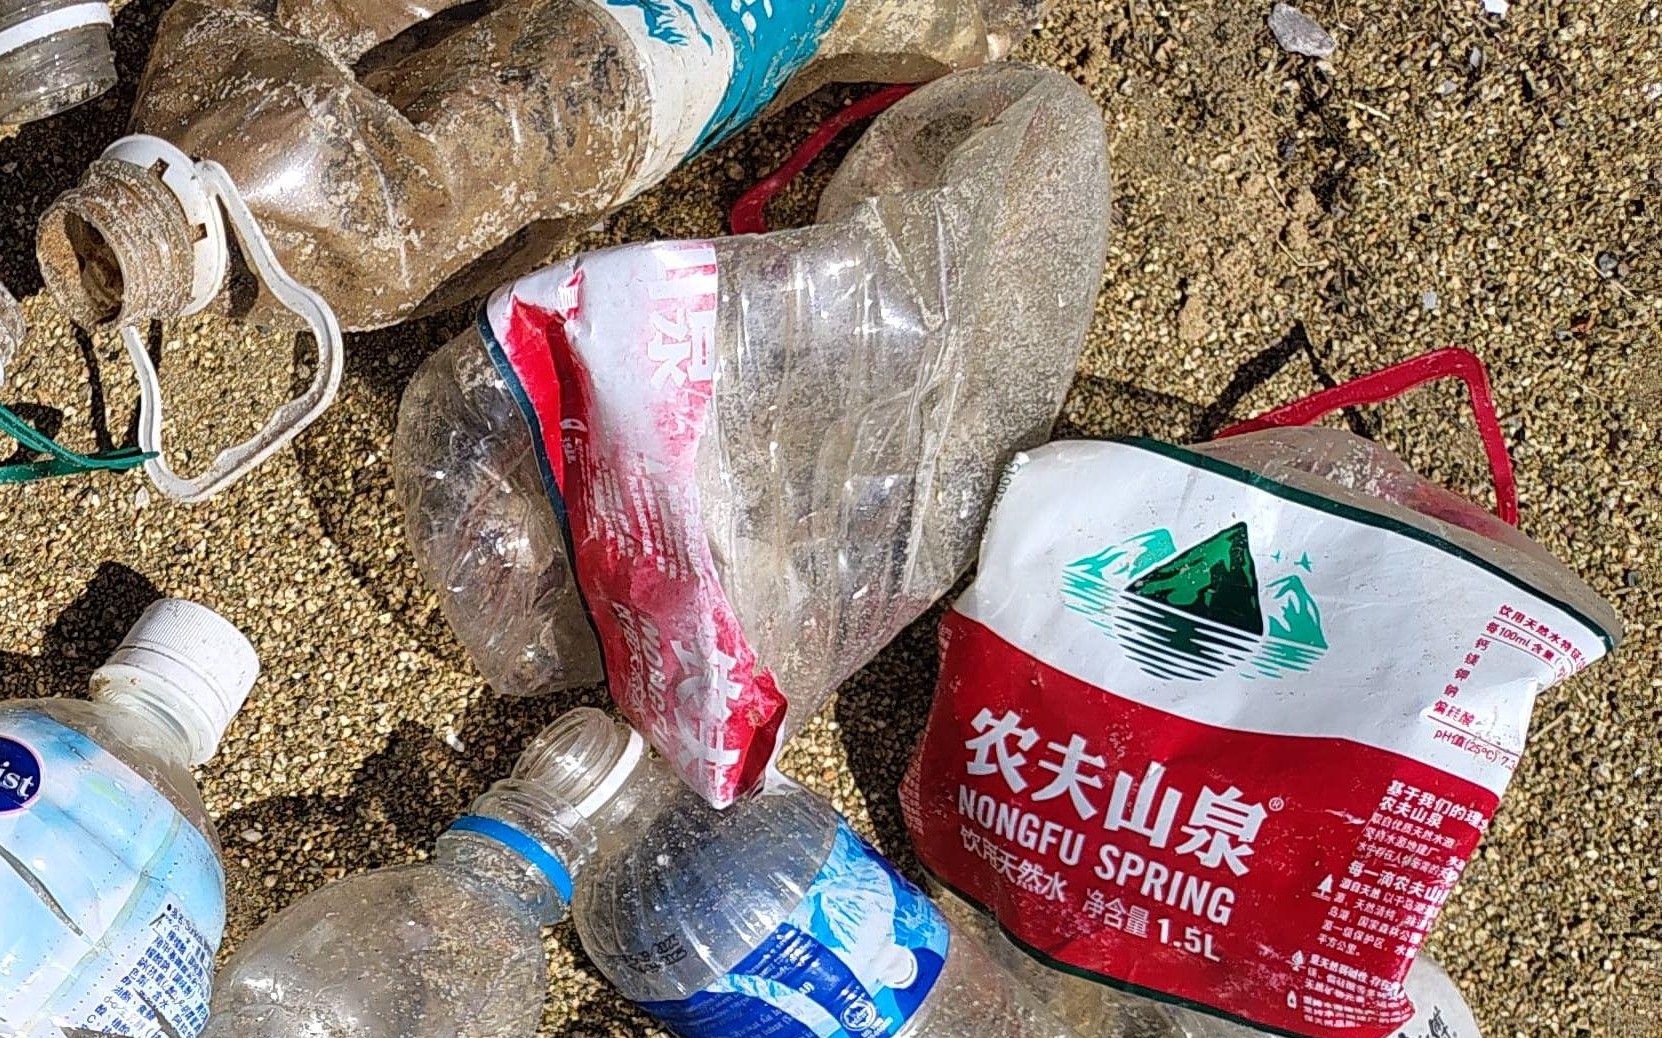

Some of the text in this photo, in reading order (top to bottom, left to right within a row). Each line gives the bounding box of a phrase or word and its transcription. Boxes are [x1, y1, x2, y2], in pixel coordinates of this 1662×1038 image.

[959, 784, 1236, 926] NONGFU SPRING
[965, 707, 1267, 877] 农夫山泉
[1379, 796, 1443, 828] 农夫山泉
[960, 824, 1221, 963] 饮用天然水 净含量 1.5L
